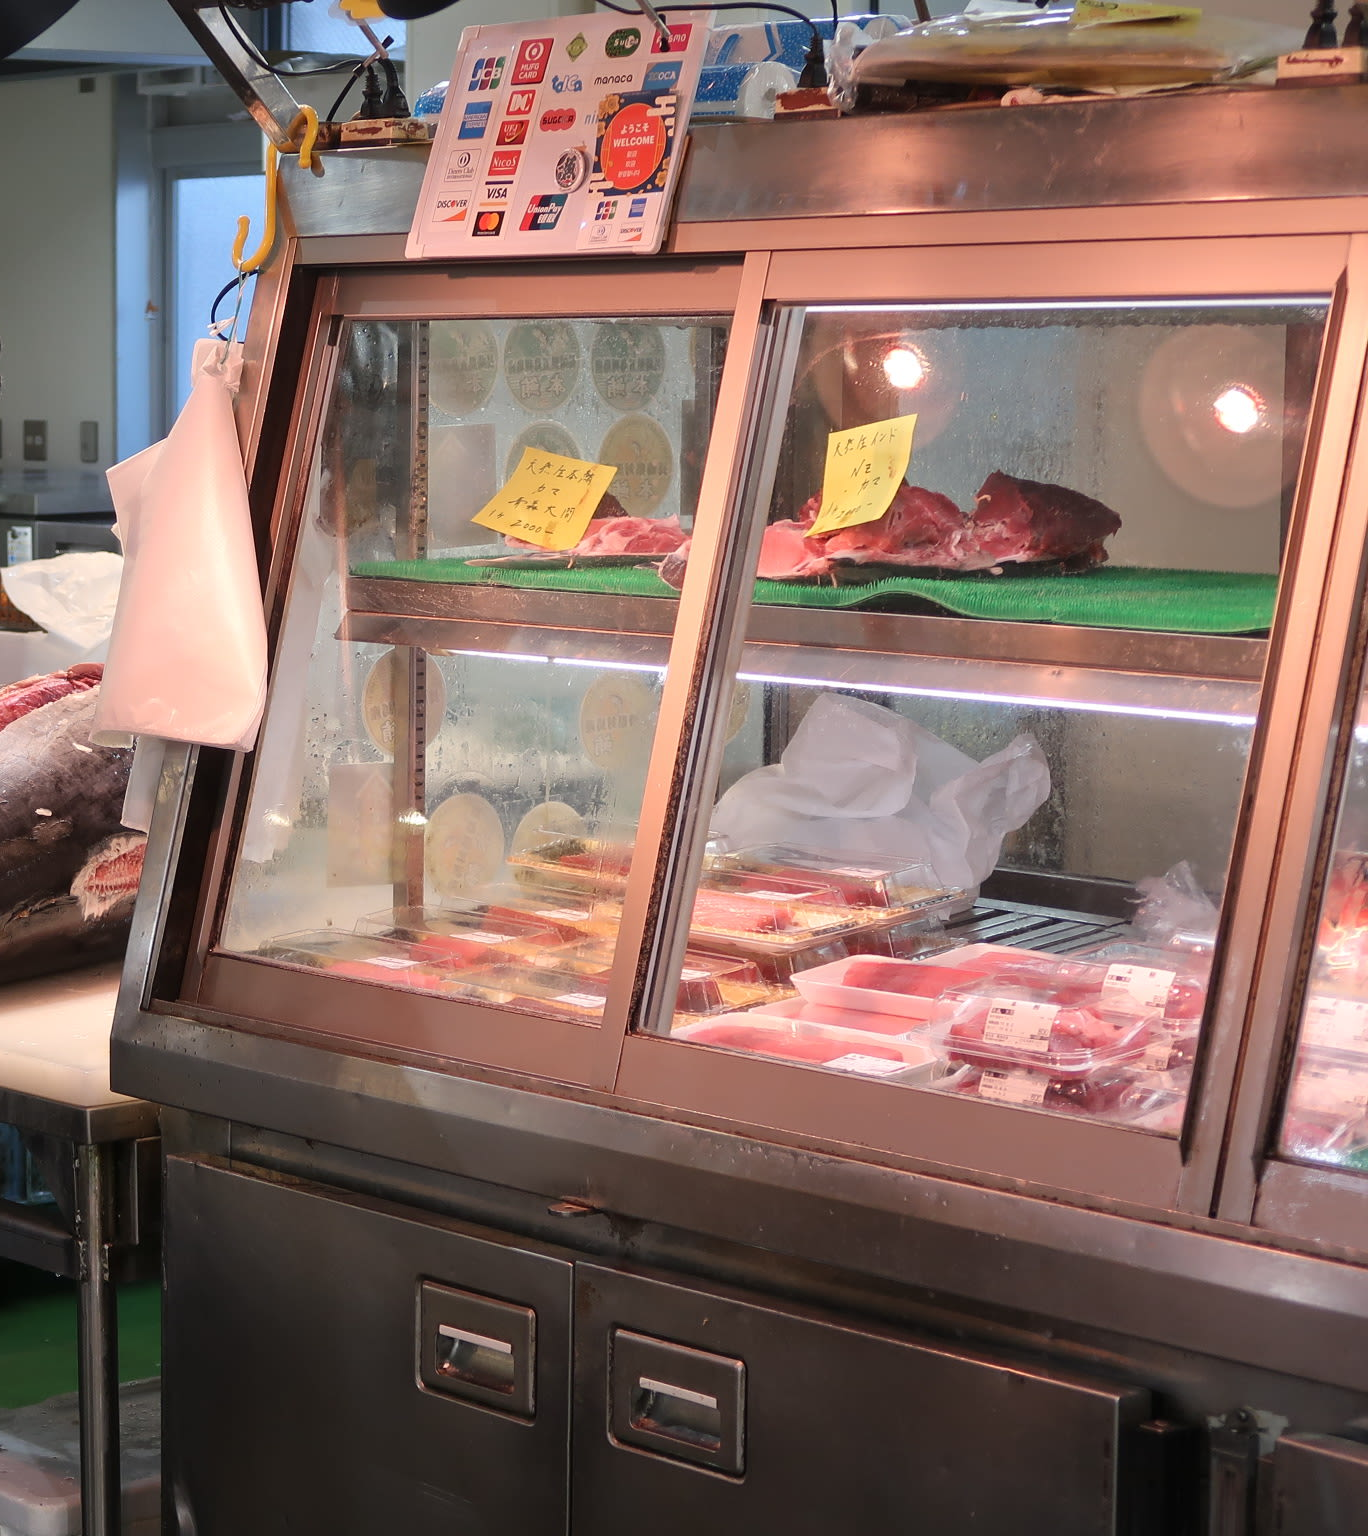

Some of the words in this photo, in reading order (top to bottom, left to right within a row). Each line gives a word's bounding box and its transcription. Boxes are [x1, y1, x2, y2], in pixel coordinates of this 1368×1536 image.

[520, 63, 540, 71] MUFG
[518, 71, 538, 79] CARD
[594, 74, 633, 85] manaca
[509, 93, 533, 112] DC
[621, 123, 650, 134] ようこそ
[613, 135, 655, 148] WELCOME
[487, 188, 507, 199] VISA
[437, 199, 468, 208] DISCOVER
[527, 203, 563, 214] UnionPay
